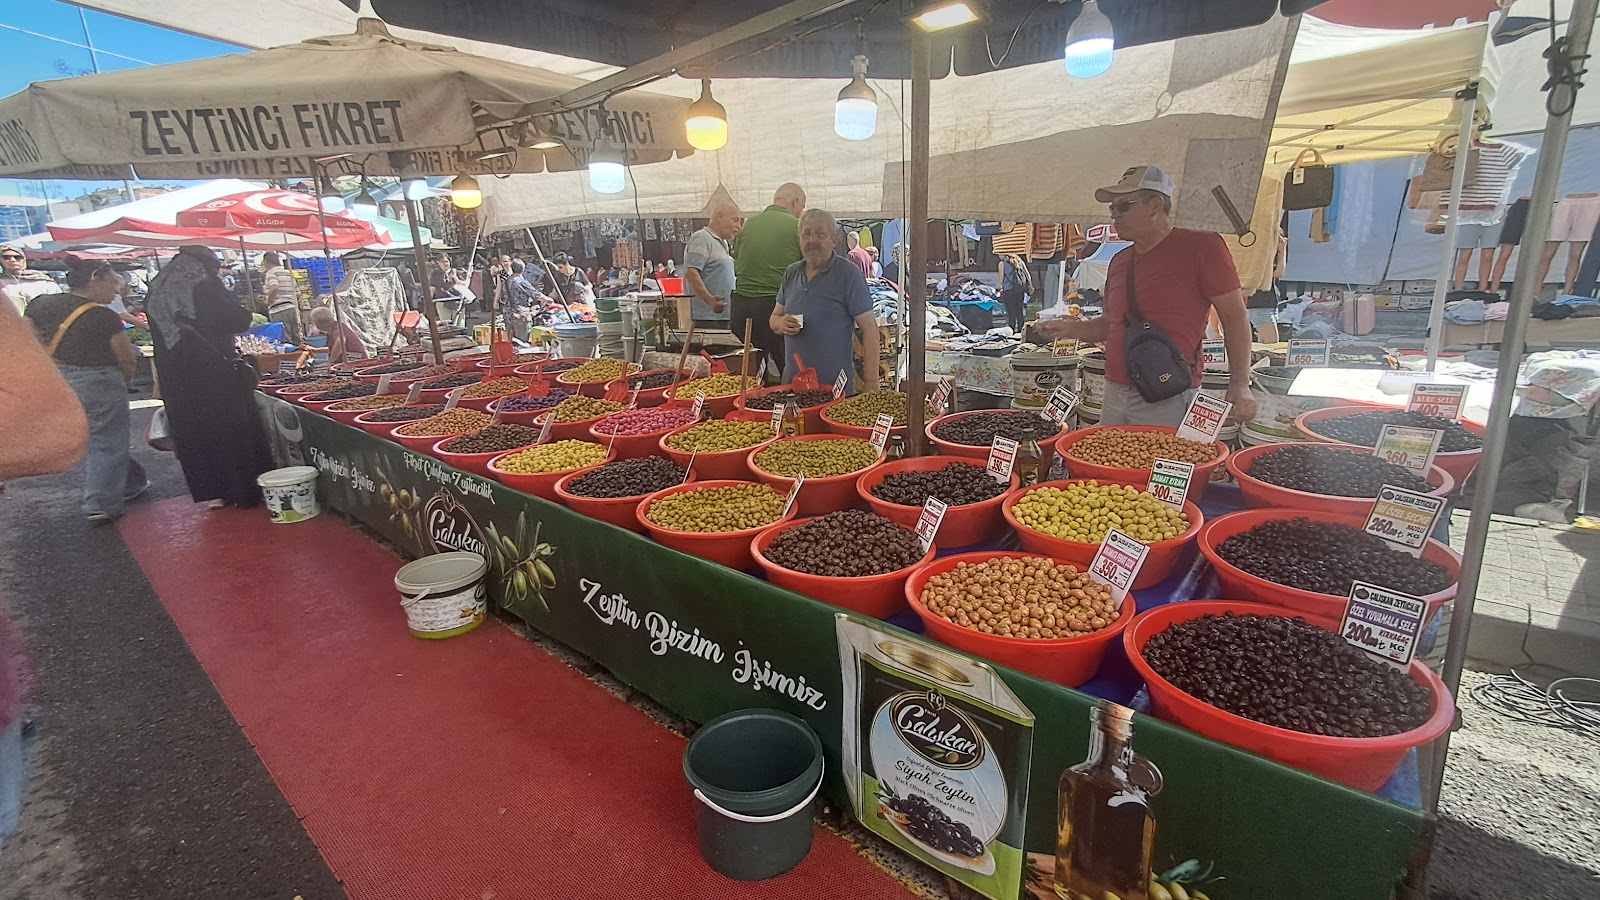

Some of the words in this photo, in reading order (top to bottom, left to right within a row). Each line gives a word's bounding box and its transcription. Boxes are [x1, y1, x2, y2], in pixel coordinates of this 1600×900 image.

[1295, 355, 1311, 364] 650
[1417, 404, 1439, 416] 400
[1190, 414, 1206, 429] 300
[1385, 450, 1408, 464] 360
[1153, 484, 1170, 500] 300
[1099, 559, 1118, 580] 350
[1350, 602, 1366, 616] ÖZEL
[1365, 608, 1398, 628] YUVAMALA
[1398, 620, 1417, 633] SELE
[579, 577, 641, 630] Zeytin
[644, 611, 725, 664] Bizim
[731, 640, 827, 711] İşimiz
[1389, 642, 1405, 652] KG
[894, 760, 932, 785] Siyah
[934, 779, 976, 805] Zeytin
